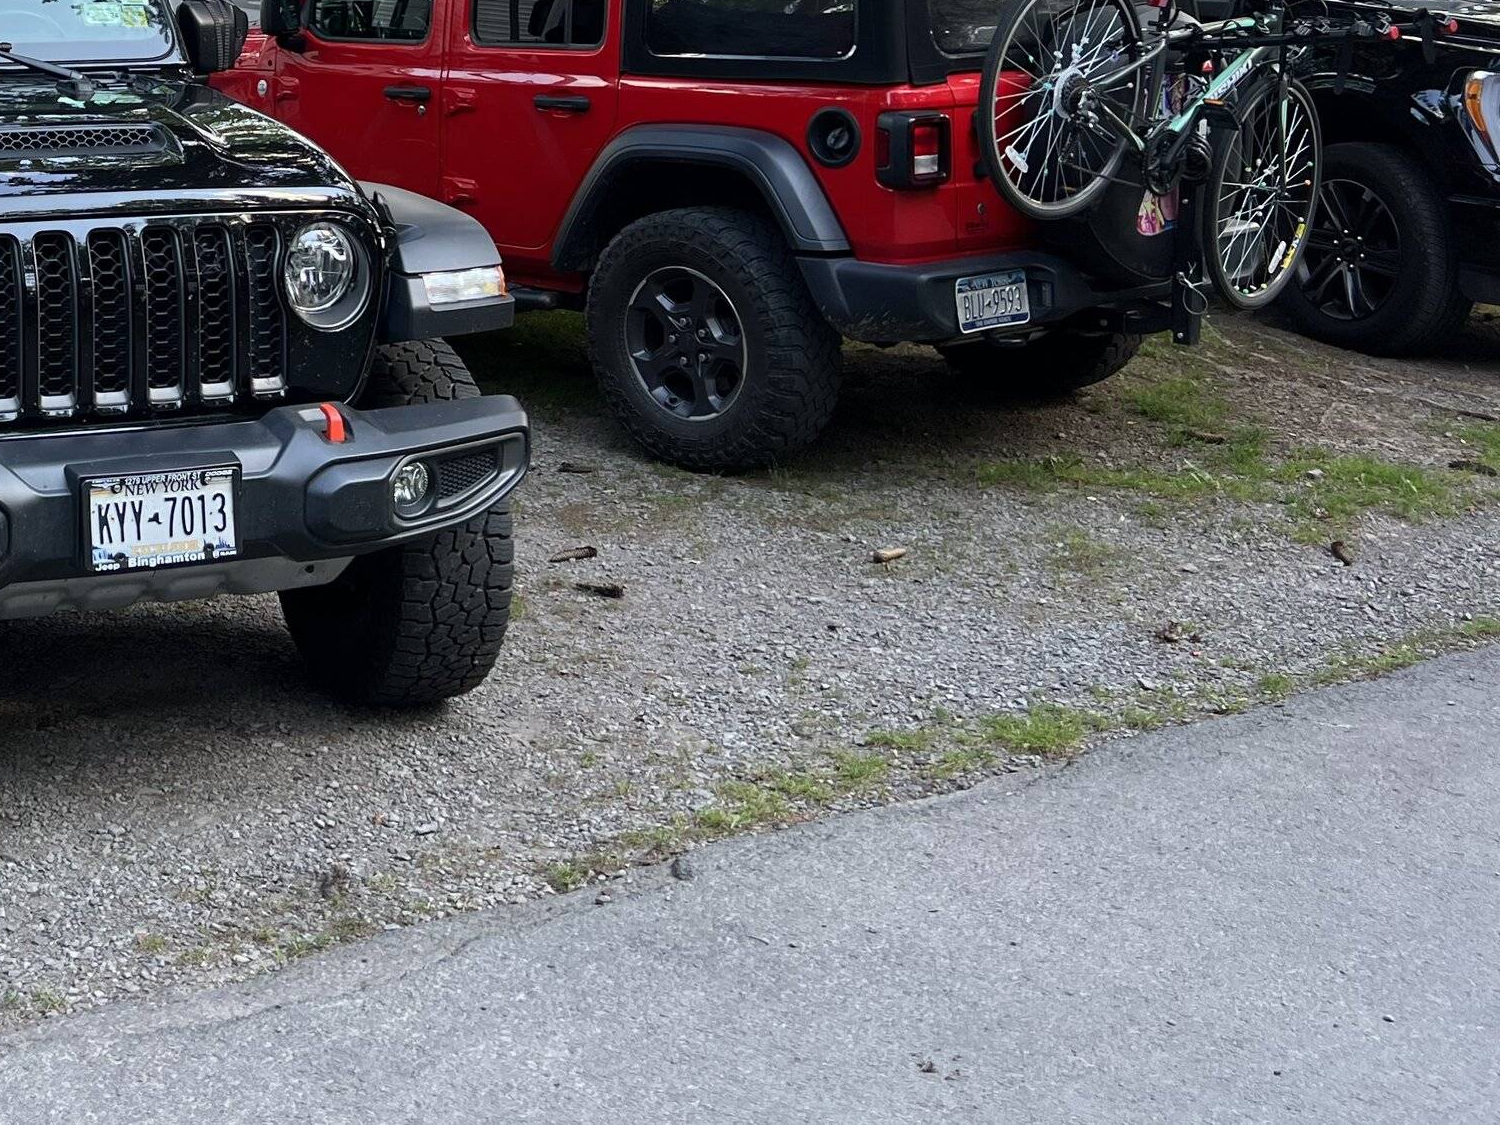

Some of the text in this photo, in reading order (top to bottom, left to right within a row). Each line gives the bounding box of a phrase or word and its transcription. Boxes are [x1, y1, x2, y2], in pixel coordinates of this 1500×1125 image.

[124, 481, 160, 497] NEW
[162, 477, 201, 493] YORK
[95, 563, 121, 572] Jeep
[127, 551, 206, 568] Binghamton
